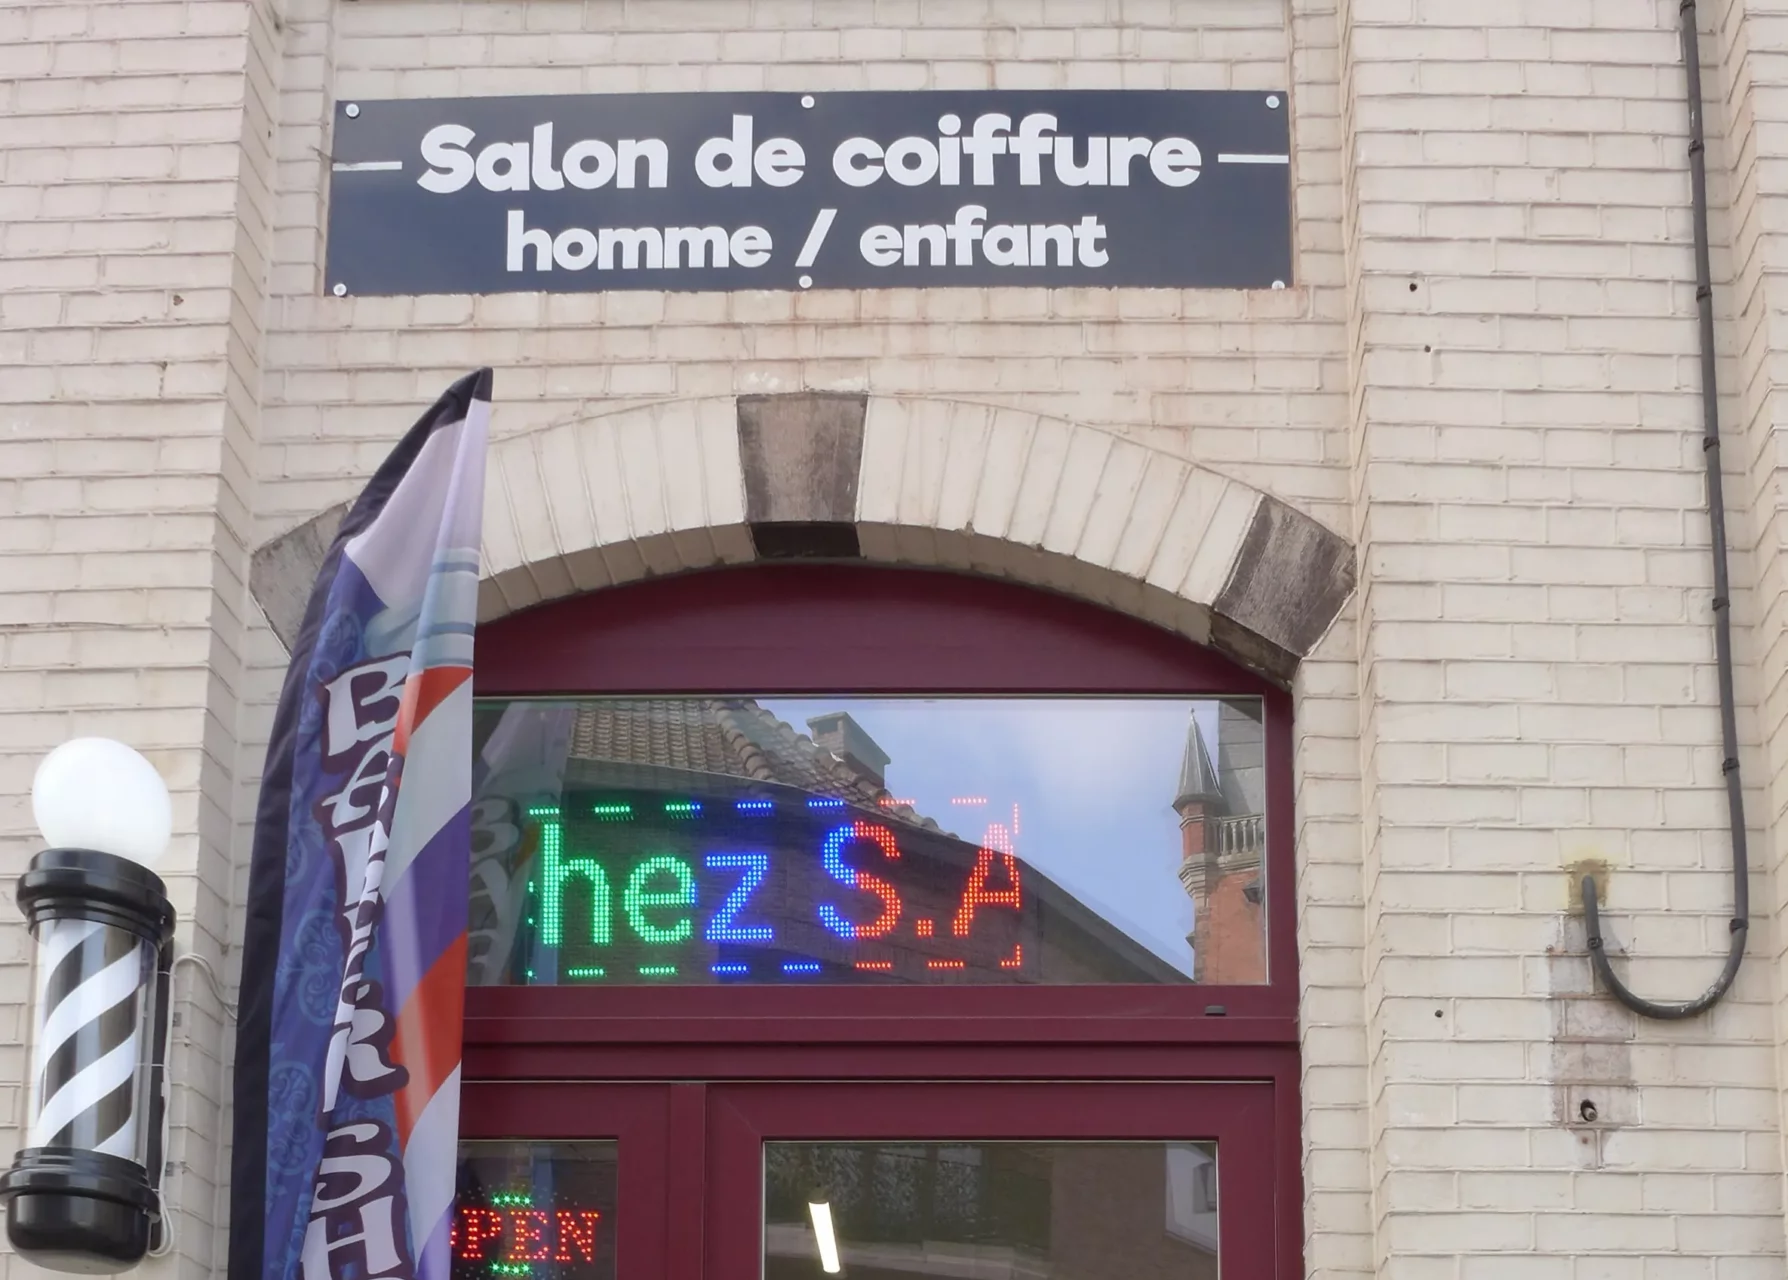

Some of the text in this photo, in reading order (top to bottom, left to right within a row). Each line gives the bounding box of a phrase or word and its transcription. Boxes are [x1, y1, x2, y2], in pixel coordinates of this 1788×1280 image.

[417, 112, 1202, 193] Salon de coiffure
[506, 205, 1110, 272] homme / enfant
[450, 1209, 601, 1262] PEN
